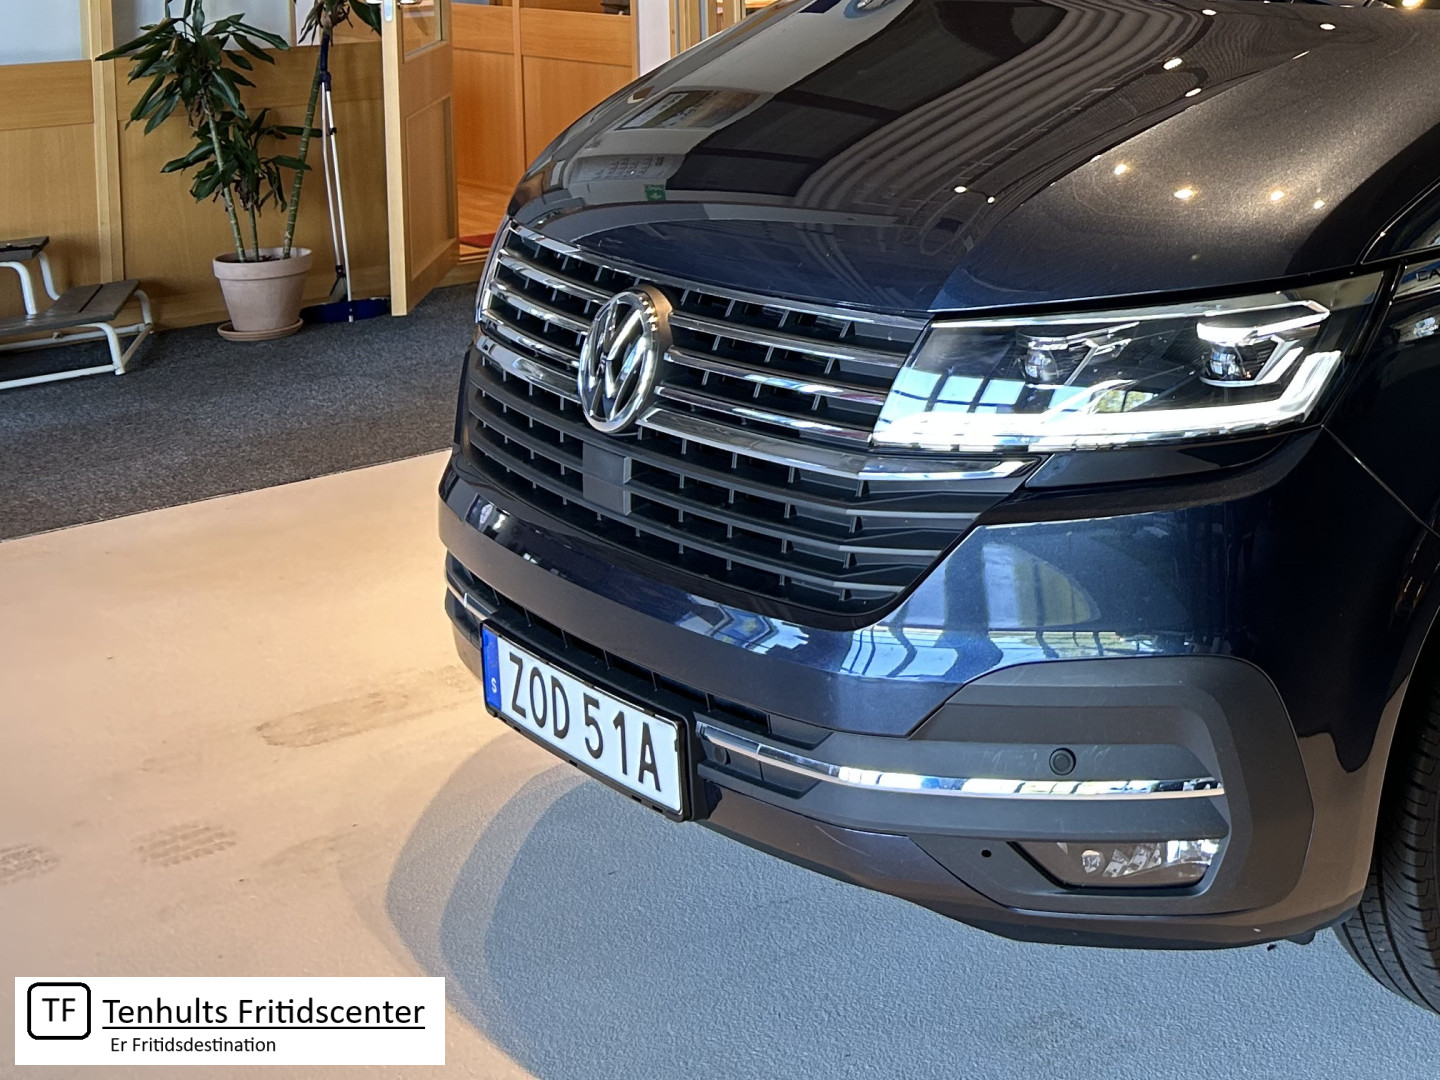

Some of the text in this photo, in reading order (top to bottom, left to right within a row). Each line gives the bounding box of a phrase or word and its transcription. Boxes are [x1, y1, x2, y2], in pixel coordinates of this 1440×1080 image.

[490, 677, 497, 694] S
[509, 652, 662, 793] ZOD 51A
